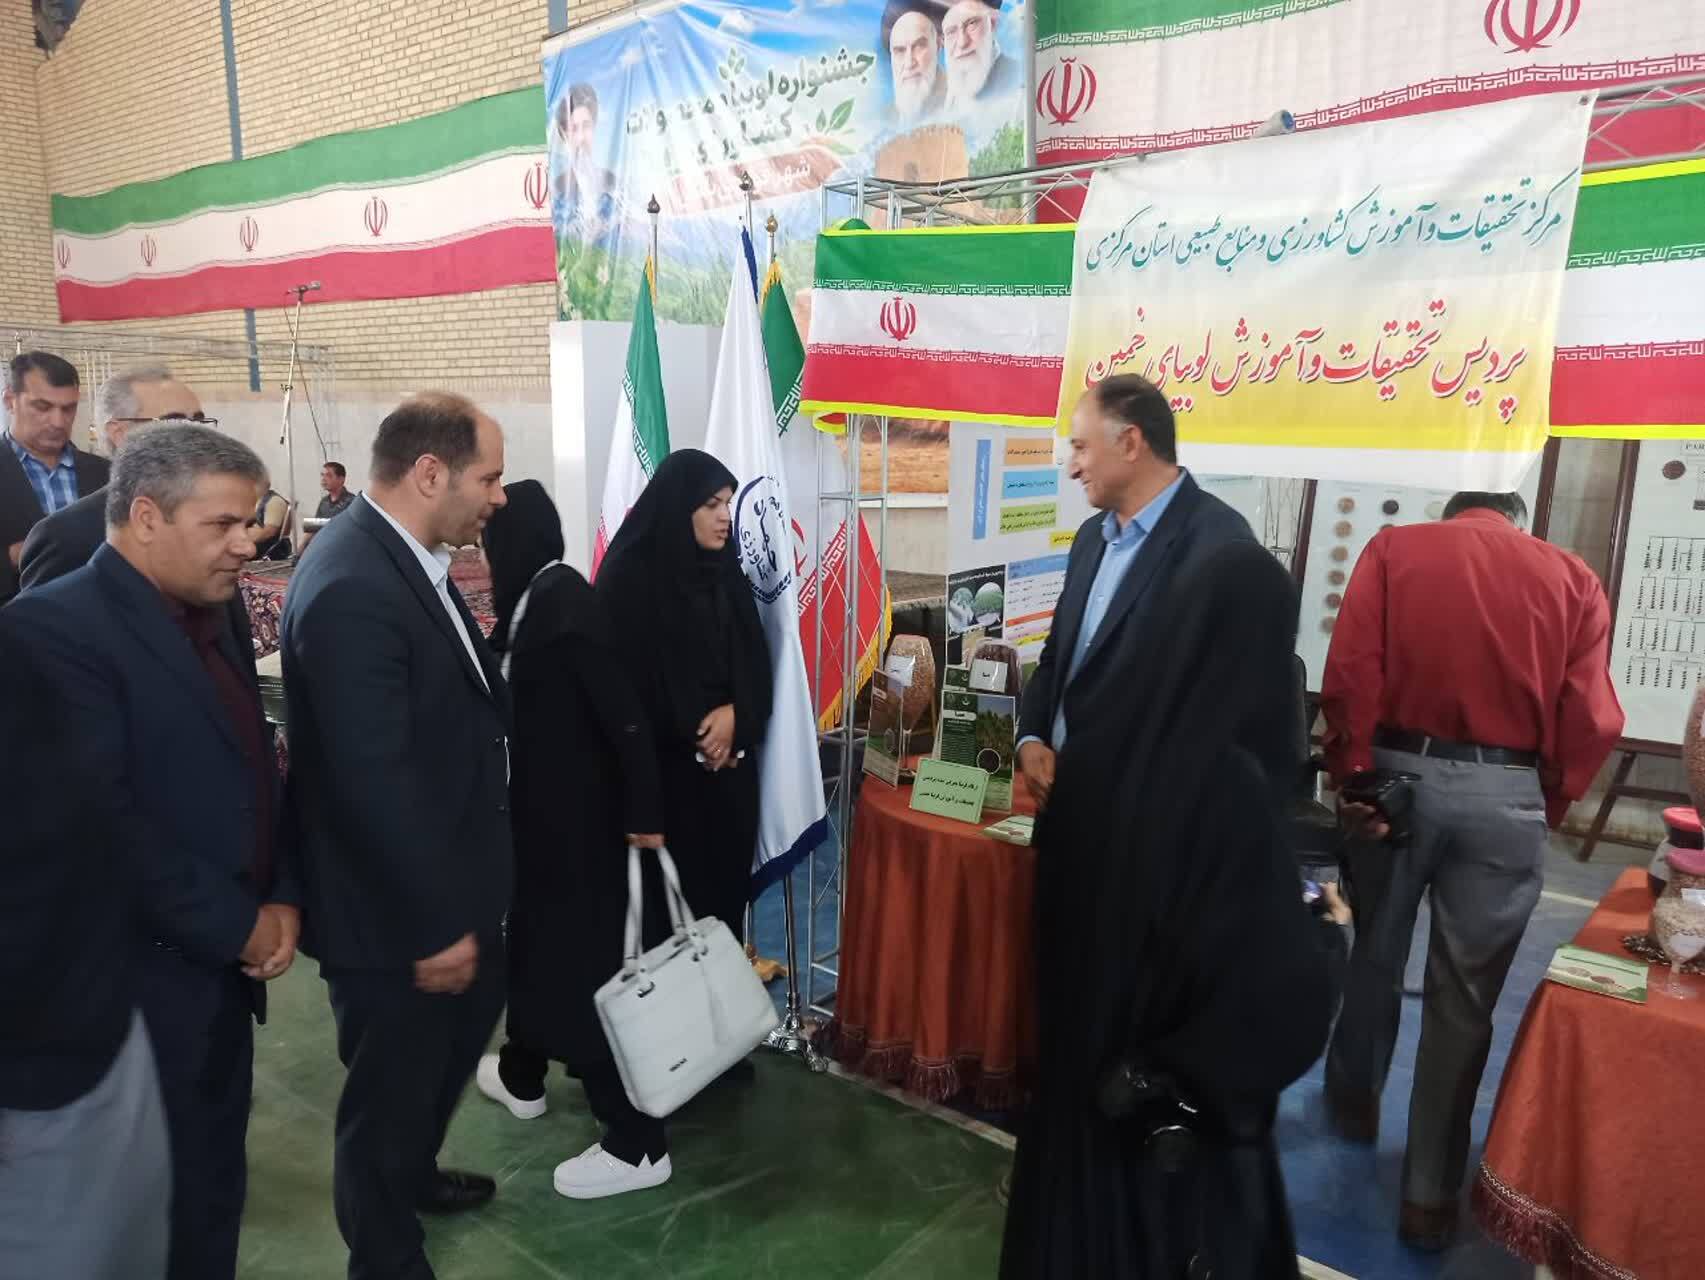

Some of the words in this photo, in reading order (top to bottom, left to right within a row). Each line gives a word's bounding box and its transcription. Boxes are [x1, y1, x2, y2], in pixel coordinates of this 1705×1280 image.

[1266, 184, 1381, 262] کشاورزی
[1347, 200, 1438, 254] آموزش
[1423, 221, 1436, 241] و
[1436, 177, 1531, 251] تحقیقات
[1522, 167, 1579, 246] مرکز
[1086, 204, 1153, 271] مرکزی
[1131, 221, 1176, 267] استان
[1175, 215, 1221, 264] طبیعی
[1215, 225, 1257, 272] منابع
[1256, 233, 1267, 251] و
[1210, 317, 1322, 393] آموزش
[1304, 353, 1322, 381] و
[1323, 299, 1444, 397] تحقیقات
[1431, 335, 1527, 420] پردیس
